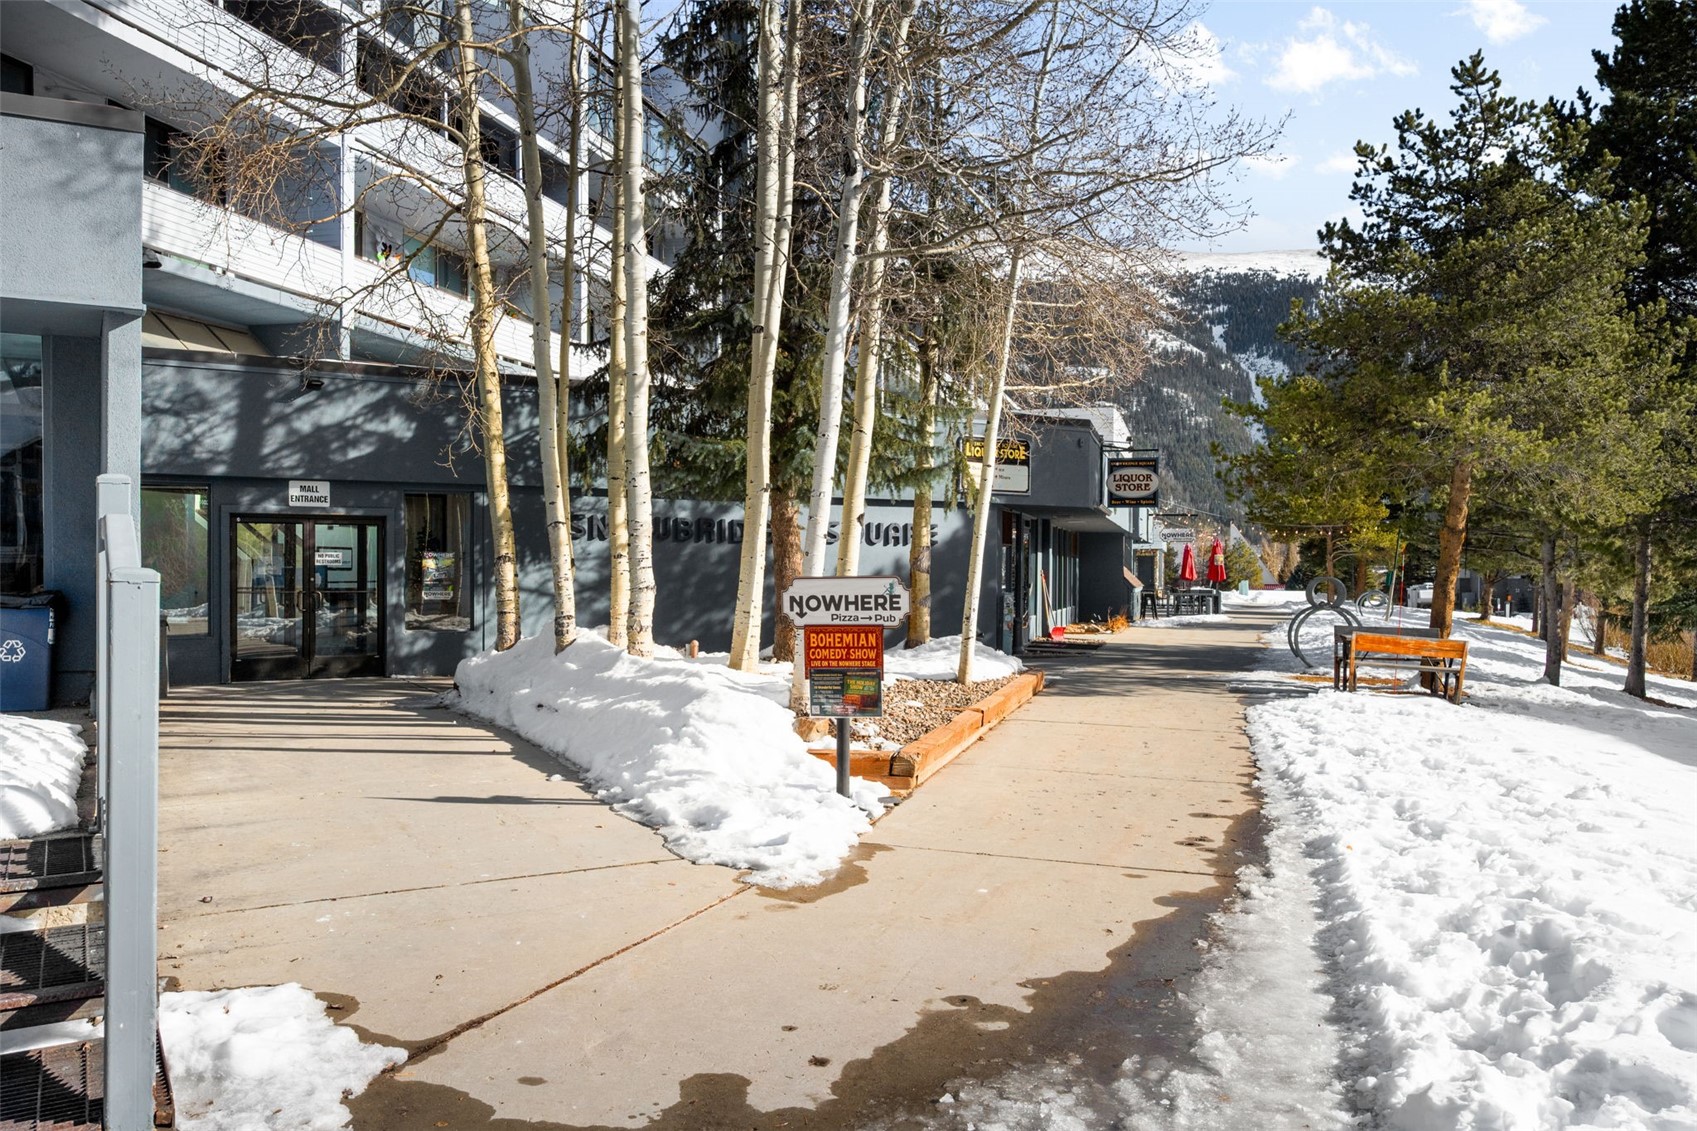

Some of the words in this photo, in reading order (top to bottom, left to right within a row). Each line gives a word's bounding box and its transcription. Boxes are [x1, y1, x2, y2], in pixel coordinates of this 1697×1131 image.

[965, 442, 999, 458] LIQ
[1000, 446, 1026, 460] STORE
[1113, 474, 1153, 483] LIQUOR
[300, 485, 319, 493] MALL
[1115, 483, 1151, 491] STORE
[290, 495, 328, 503] ENTRANCE
[789, 594, 902, 618] NOWHERE
[831, 613, 859, 622] Pizza
[874, 613, 896, 622] Pub
[810, 633, 876, 647] BOHEMIAN
[809, 648, 847, 659] COMEDY
[849, 648, 877, 659] SHOW
